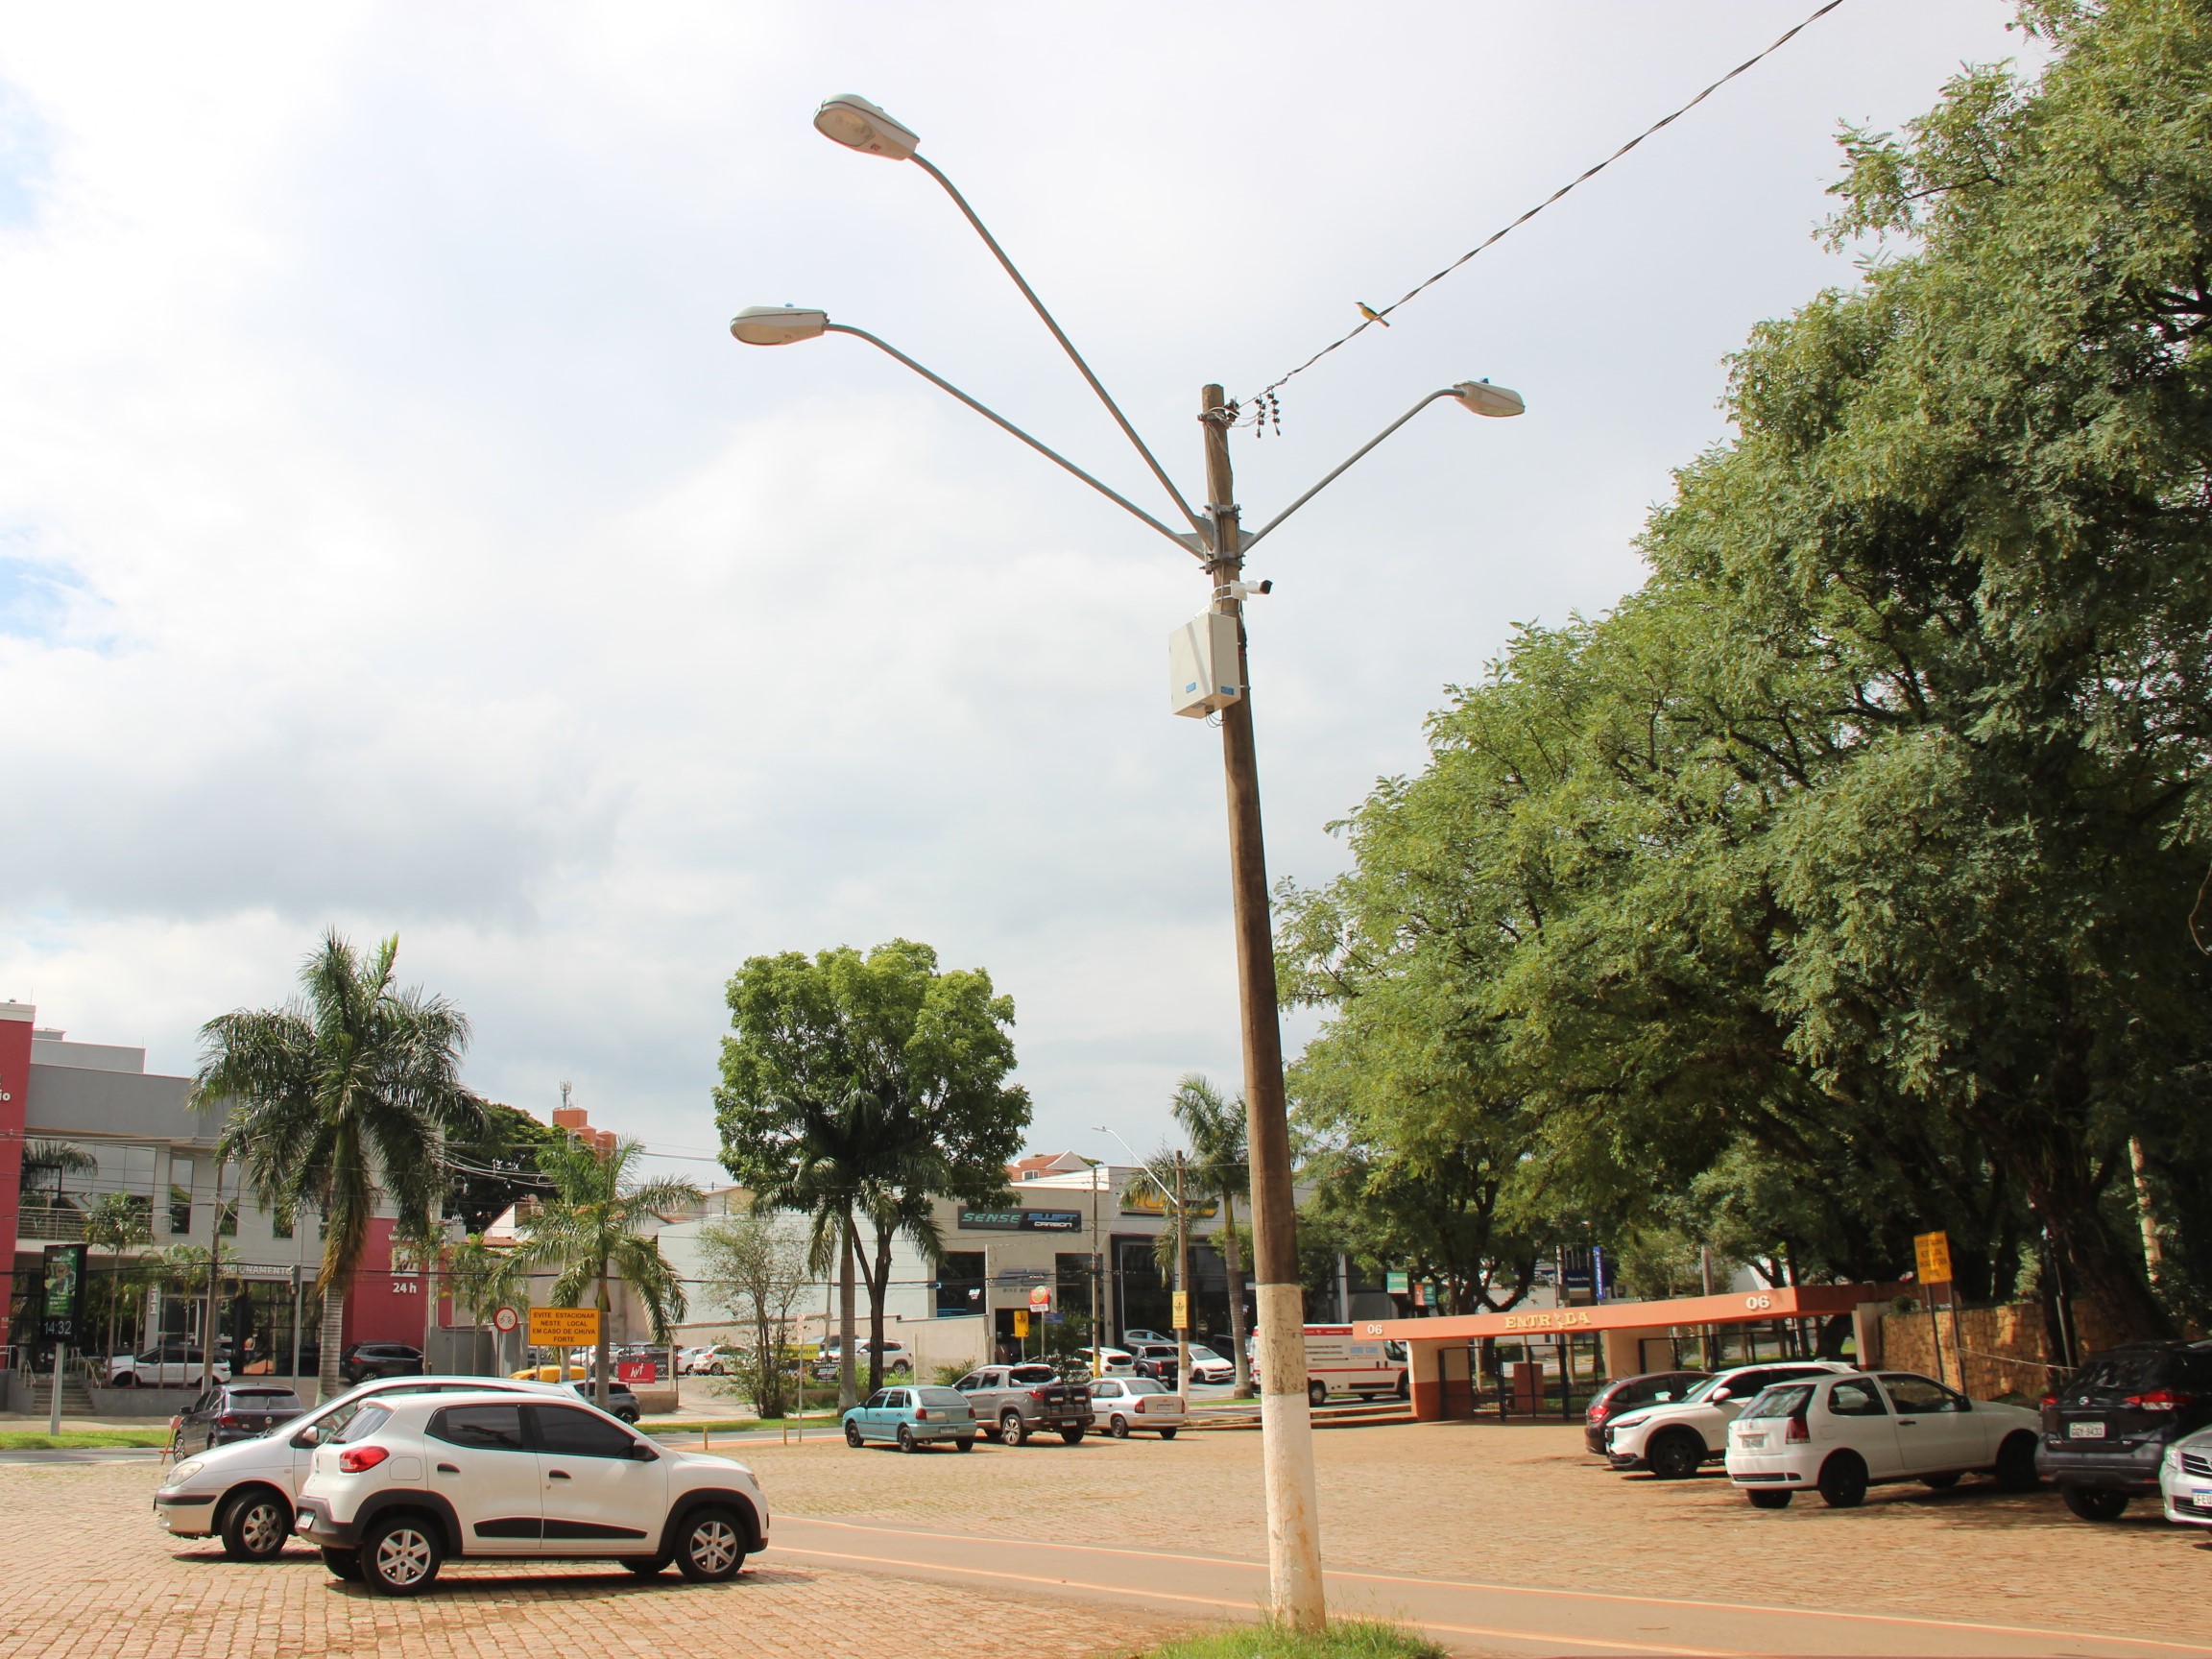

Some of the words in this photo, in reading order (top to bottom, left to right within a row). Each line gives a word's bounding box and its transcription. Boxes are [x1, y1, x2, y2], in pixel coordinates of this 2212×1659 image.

[961, 1213, 1022, 1223] SENSE
[1027, 1213, 1077, 1221] SWIFT
[393, 1282, 407, 1293] 24
[409, 1282, 418, 1294] h
[1745, 1295, 1770, 1310] 06
[44, 1320, 72, 1335] 14:32
[1367, 1324, 1382, 1335] 06
